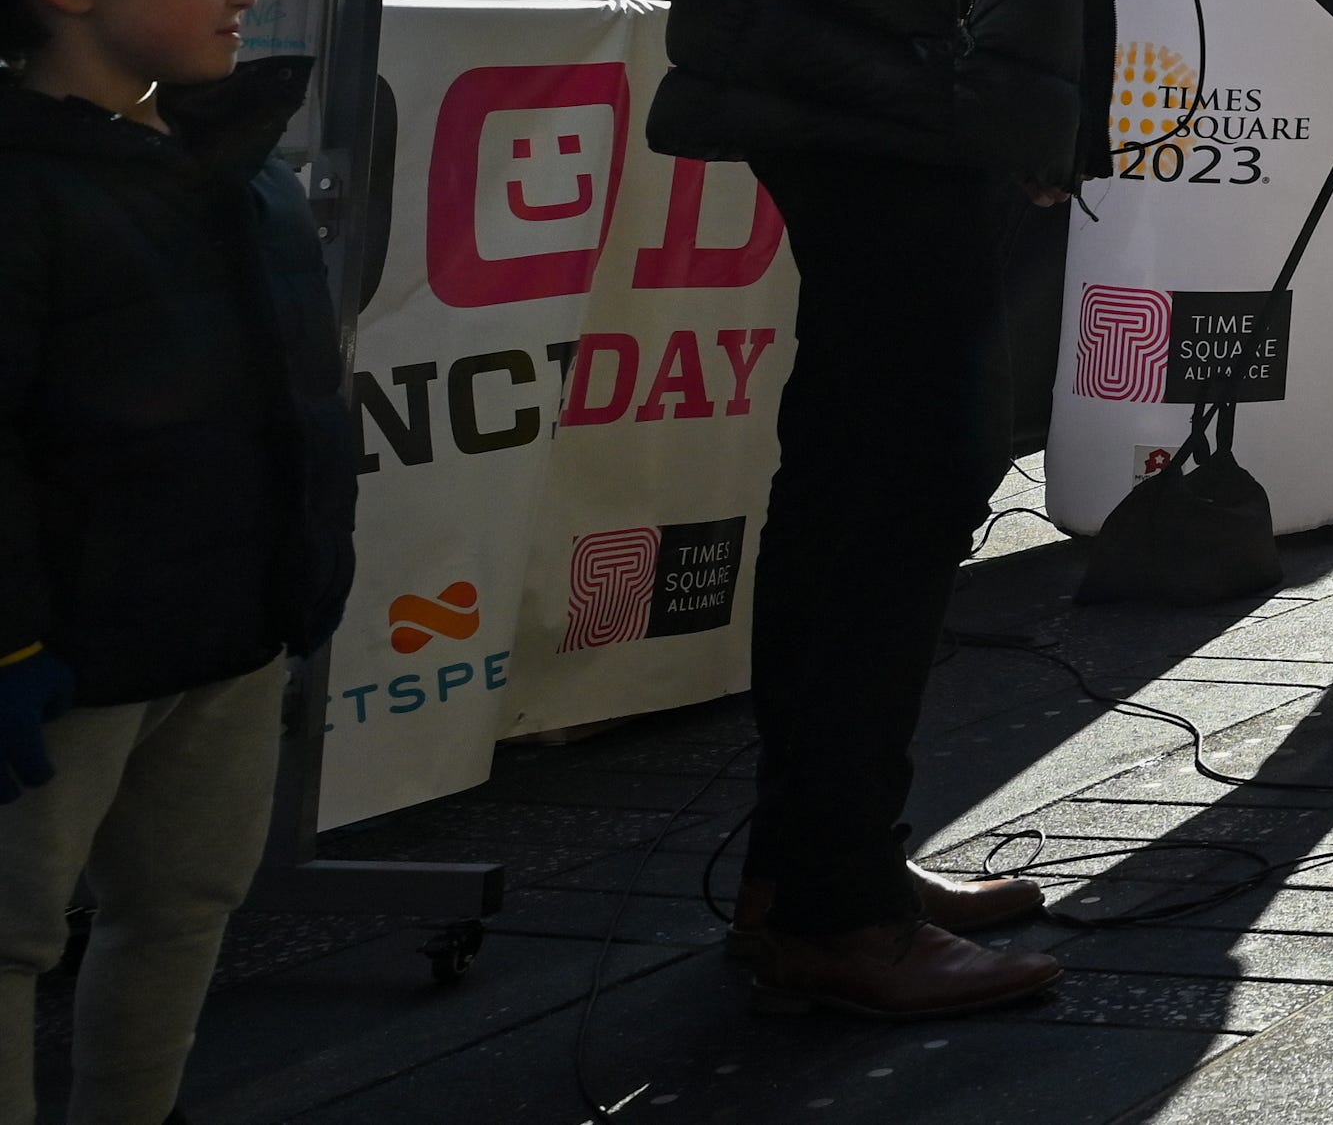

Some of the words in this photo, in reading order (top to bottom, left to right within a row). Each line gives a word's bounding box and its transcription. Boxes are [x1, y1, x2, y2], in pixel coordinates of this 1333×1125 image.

[1158, 85, 1262, 113] TIMES
[1175, 114, 1310, 145] SQUARE
[1119, 142, 1262, 186] 2023
[1192, 314, 1270, 334] TIME
[559, 329, 776, 428] DAY
[678, 541, 730, 565] TIMES
[665, 565, 731, 593] SQUARE
[667, 589, 726, 613] ALLIANCE
[323, 651, 511, 732] TSPE
